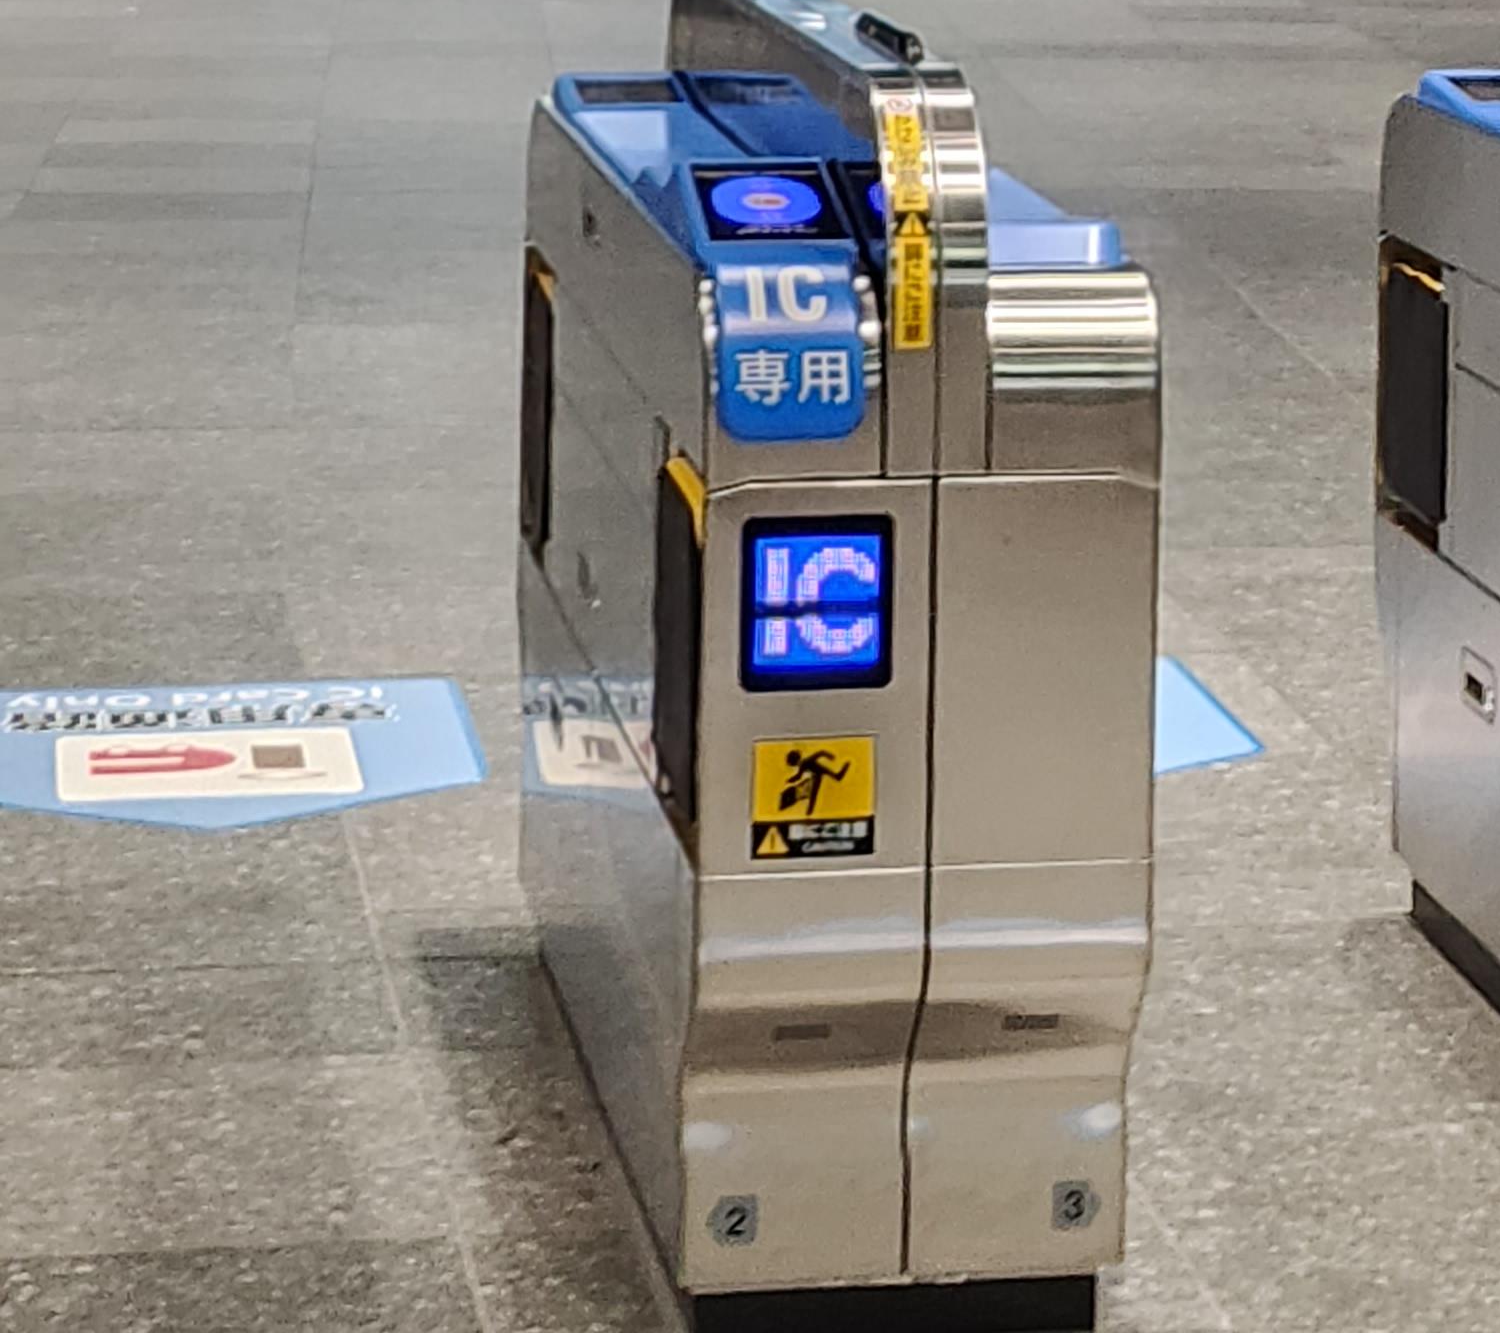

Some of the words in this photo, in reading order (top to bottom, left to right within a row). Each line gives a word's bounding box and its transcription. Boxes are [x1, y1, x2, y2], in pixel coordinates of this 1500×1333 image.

[744, 265, 828, 324] IC
[734, 349, 851, 406] 専用
[763, 547, 877, 656] IC
[724, 1206, 748, 1236] 2
[1063, 1189, 1087, 1222] 3
